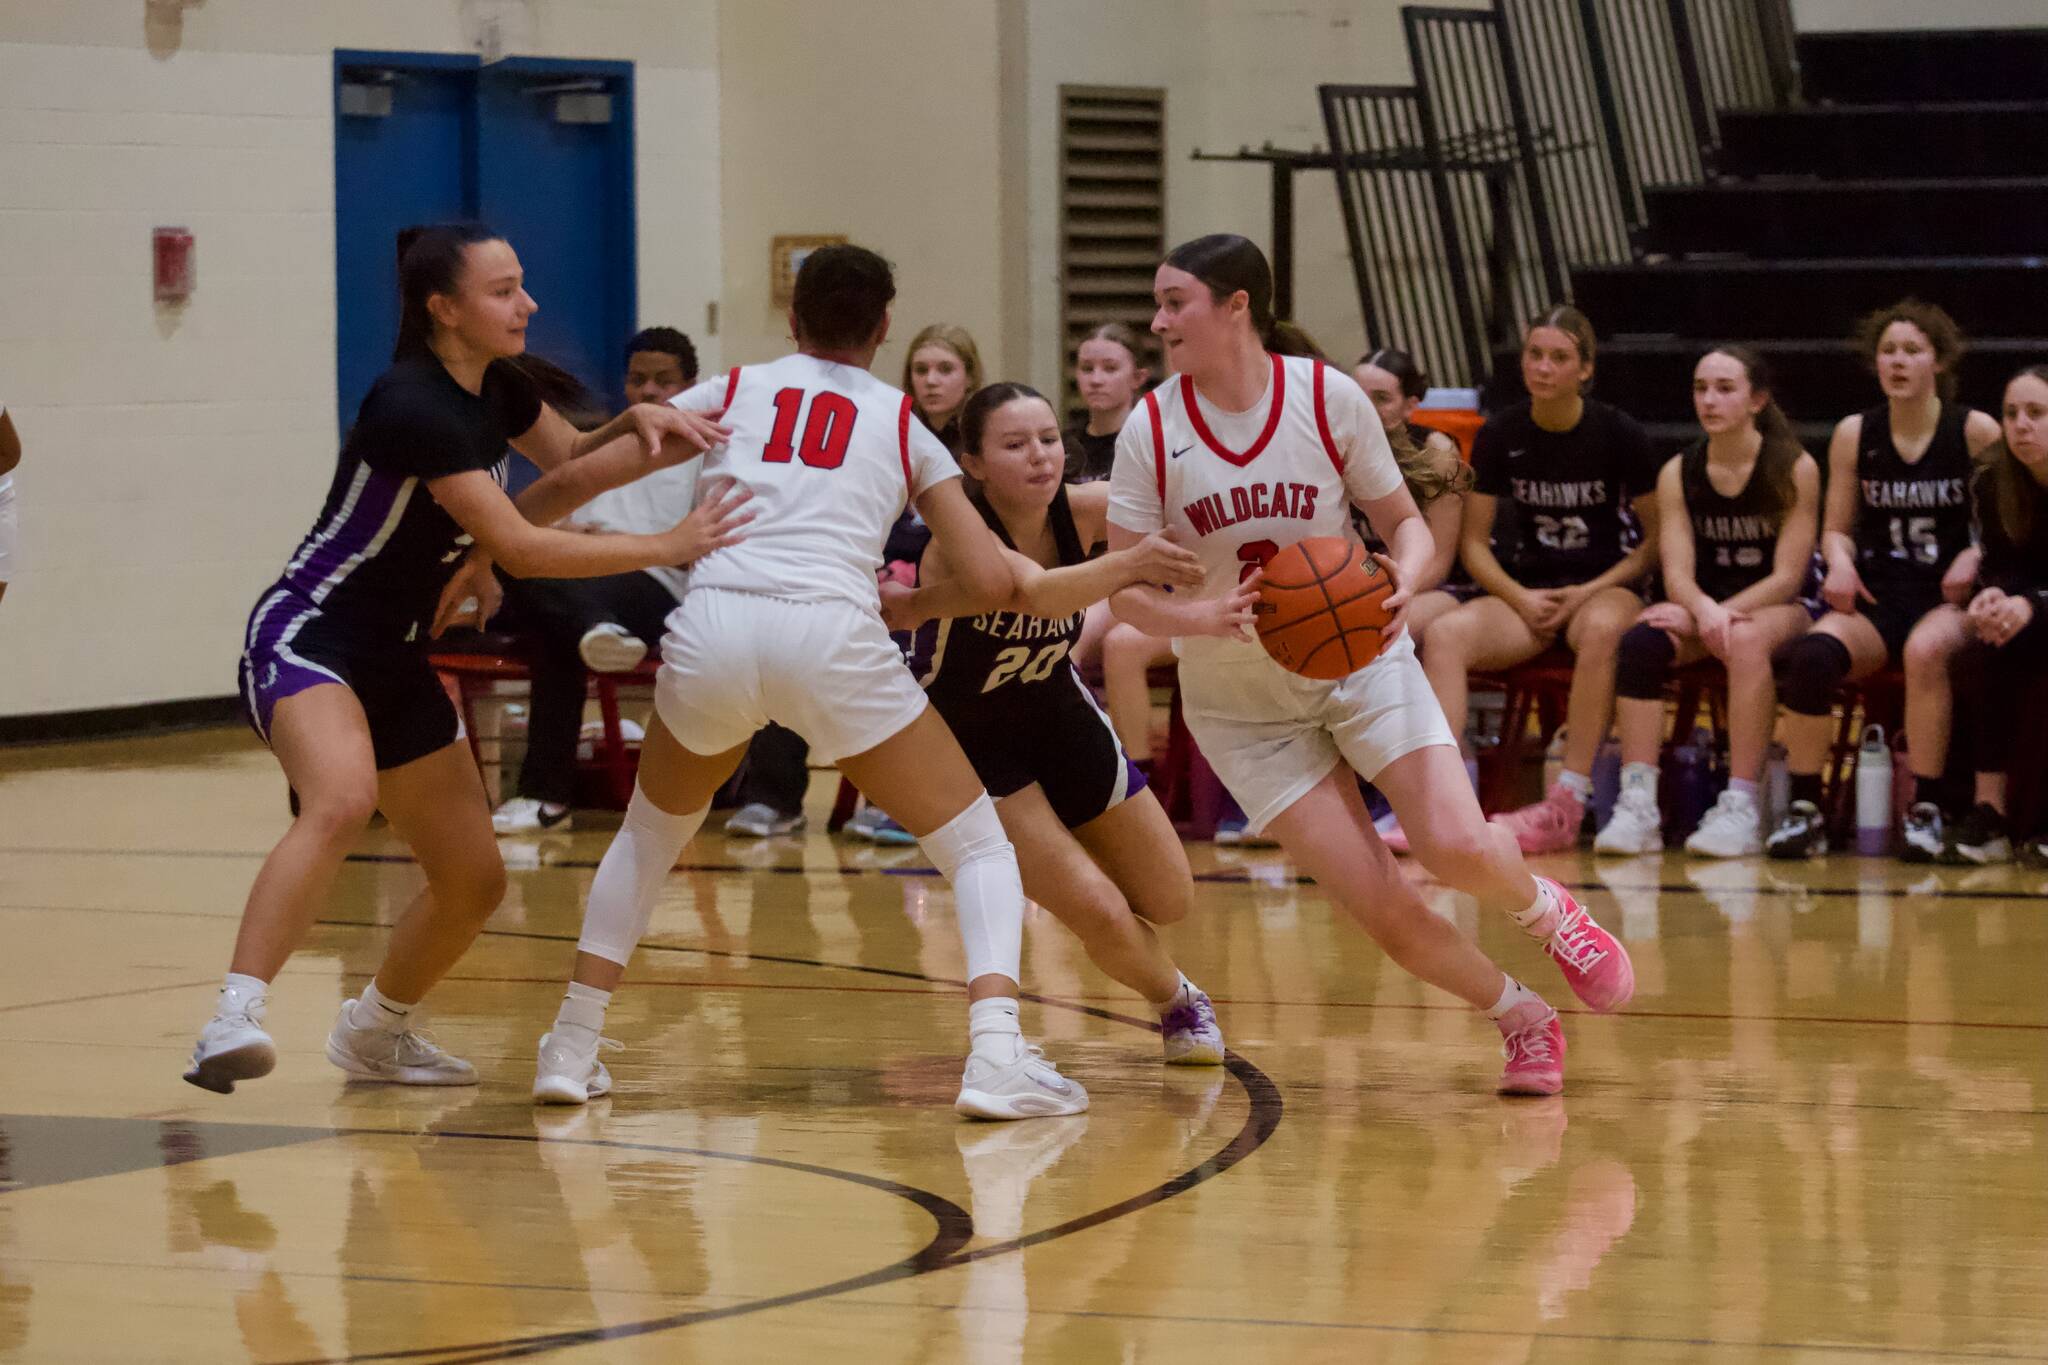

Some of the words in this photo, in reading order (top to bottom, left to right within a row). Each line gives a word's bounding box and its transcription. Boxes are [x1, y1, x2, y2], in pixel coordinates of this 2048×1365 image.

[761, 386, 859, 470] 10
[1183, 482, 1319, 537] WILDCATS
[1510, 478, 1606, 507] EAHAWKS
[1533, 515, 1590, 550] 22
[1888, 516, 1938, 564] 15
[980, 639, 1071, 694] 20
